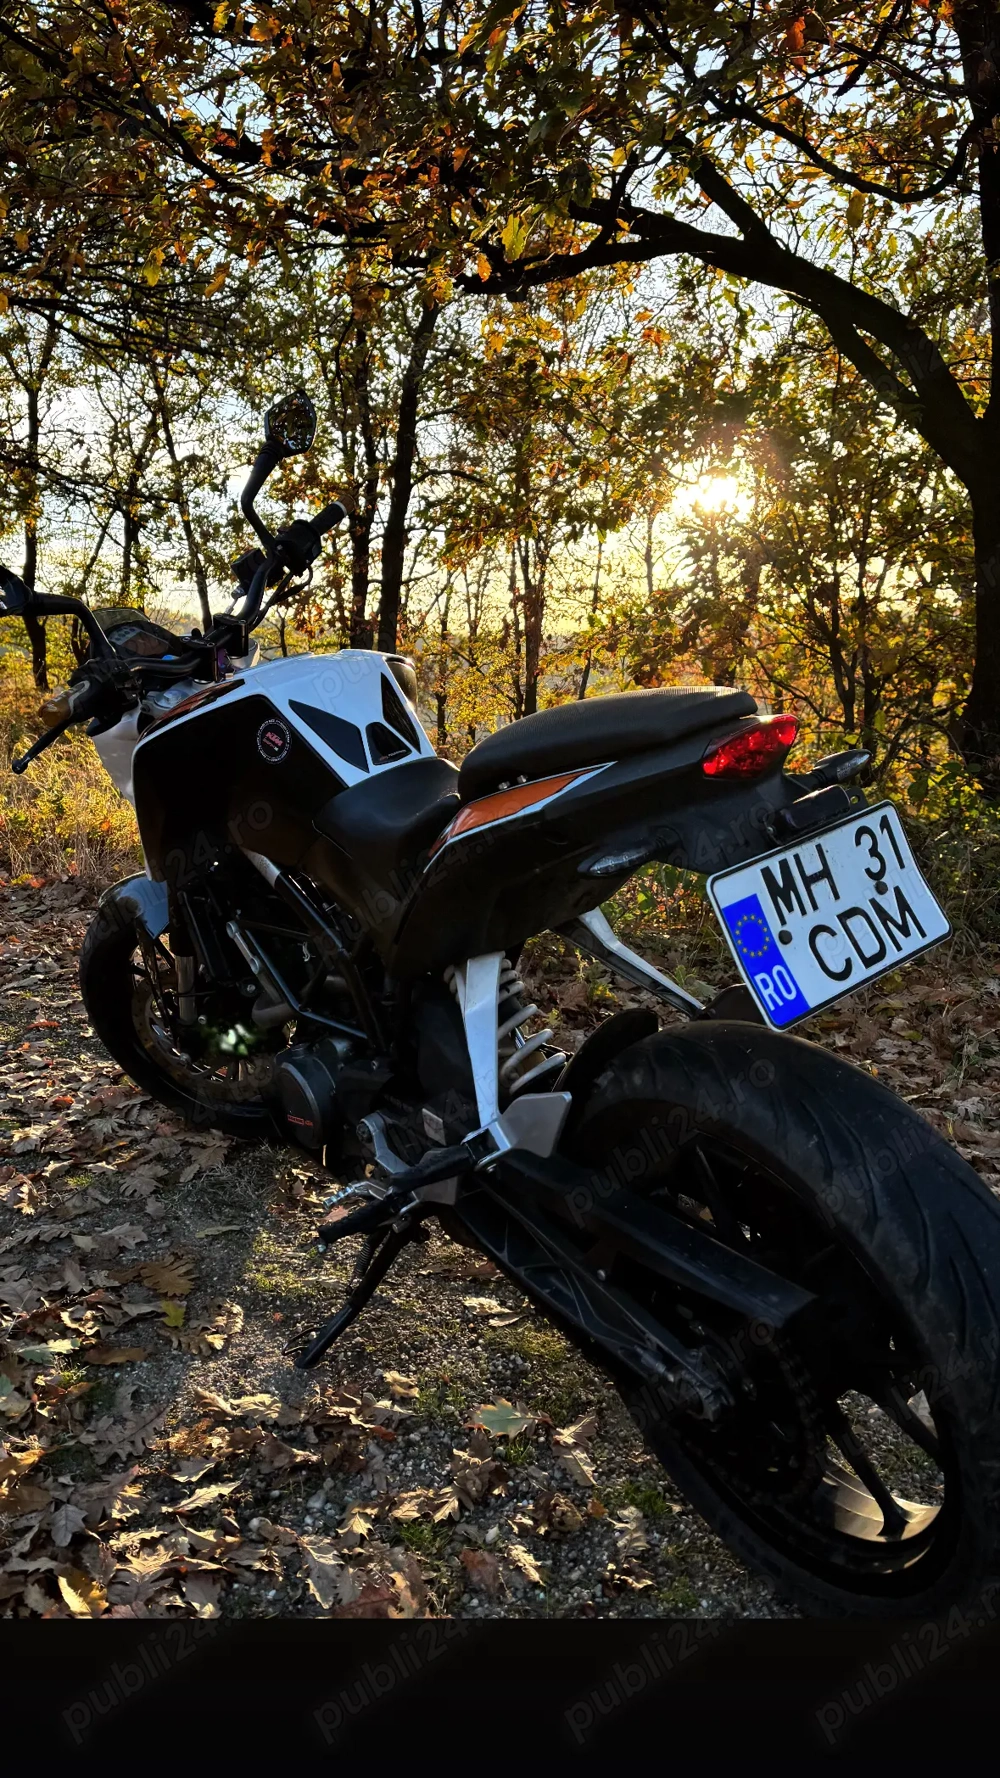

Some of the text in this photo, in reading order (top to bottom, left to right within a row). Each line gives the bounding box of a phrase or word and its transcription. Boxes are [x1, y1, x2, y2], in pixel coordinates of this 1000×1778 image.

[760, 843, 841, 926] MH
[854, 814, 906, 881] 31
[808, 885, 928, 982] CDM
[754, 964, 798, 1011] RO
